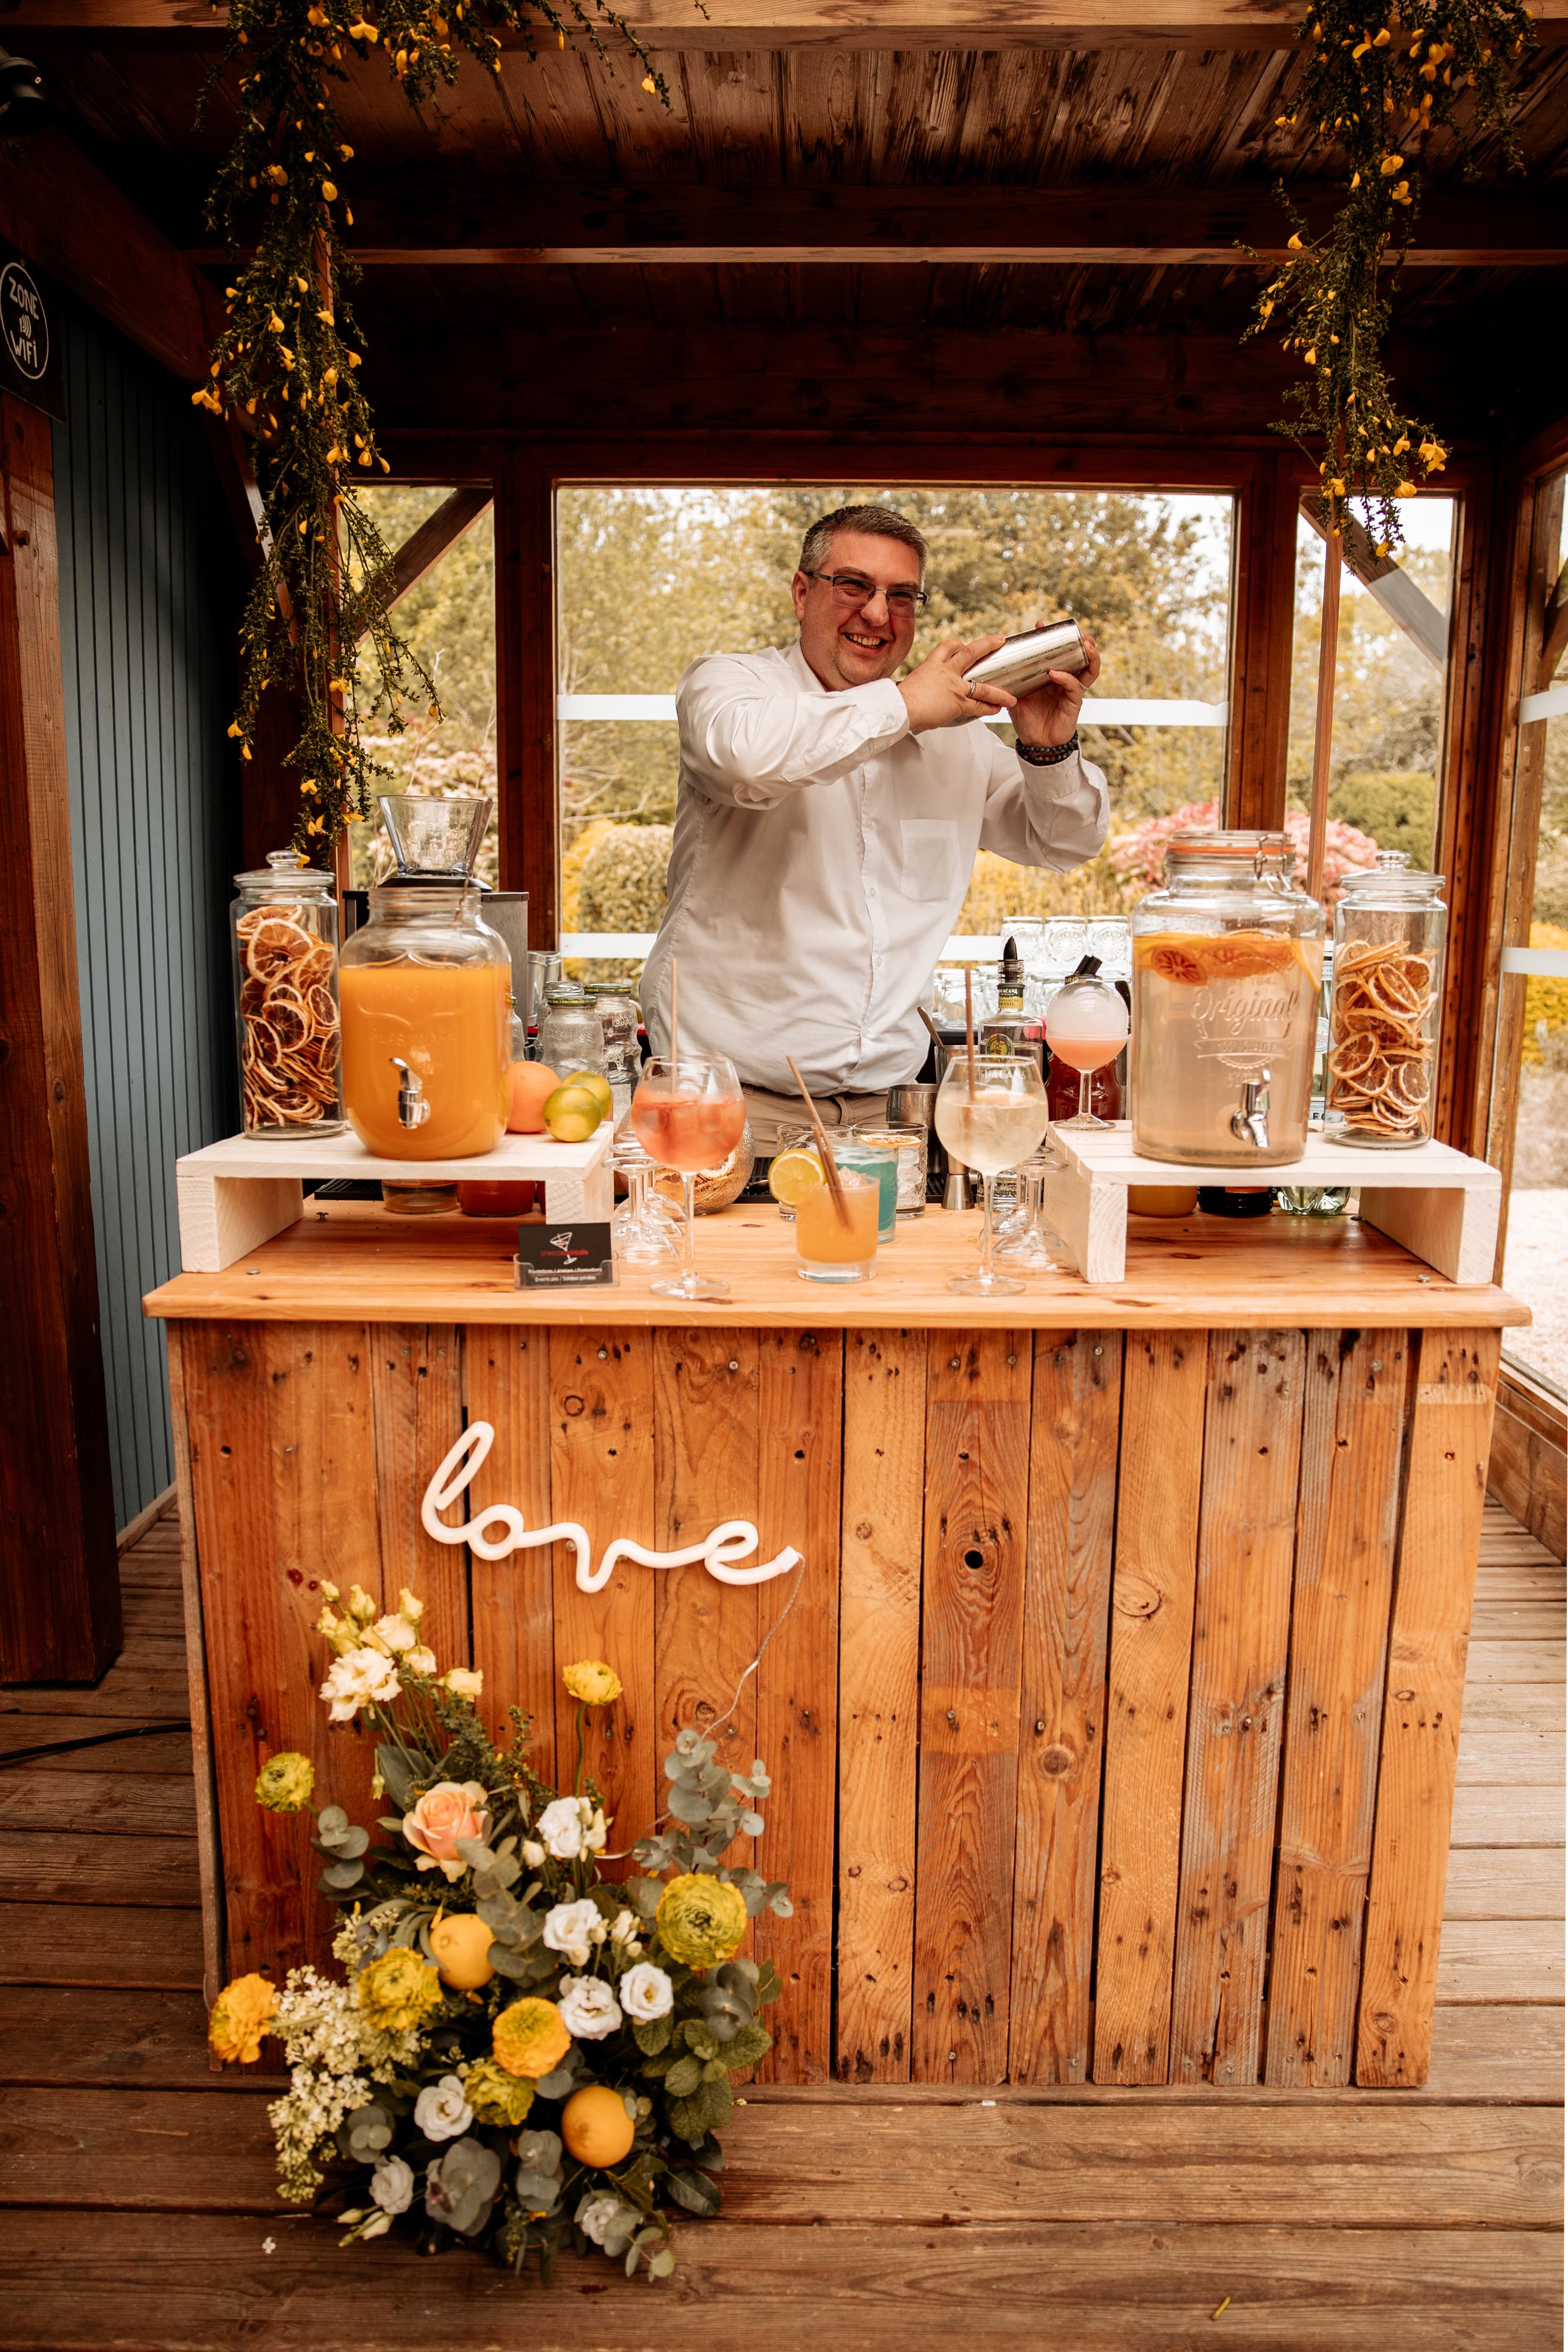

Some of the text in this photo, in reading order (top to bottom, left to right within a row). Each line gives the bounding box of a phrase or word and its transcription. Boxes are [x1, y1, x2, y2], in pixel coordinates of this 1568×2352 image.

[9, 276, 39, 320] ZONE
[1191, 986, 1300, 1035] Original
[422, 1421, 799, 1594] love
